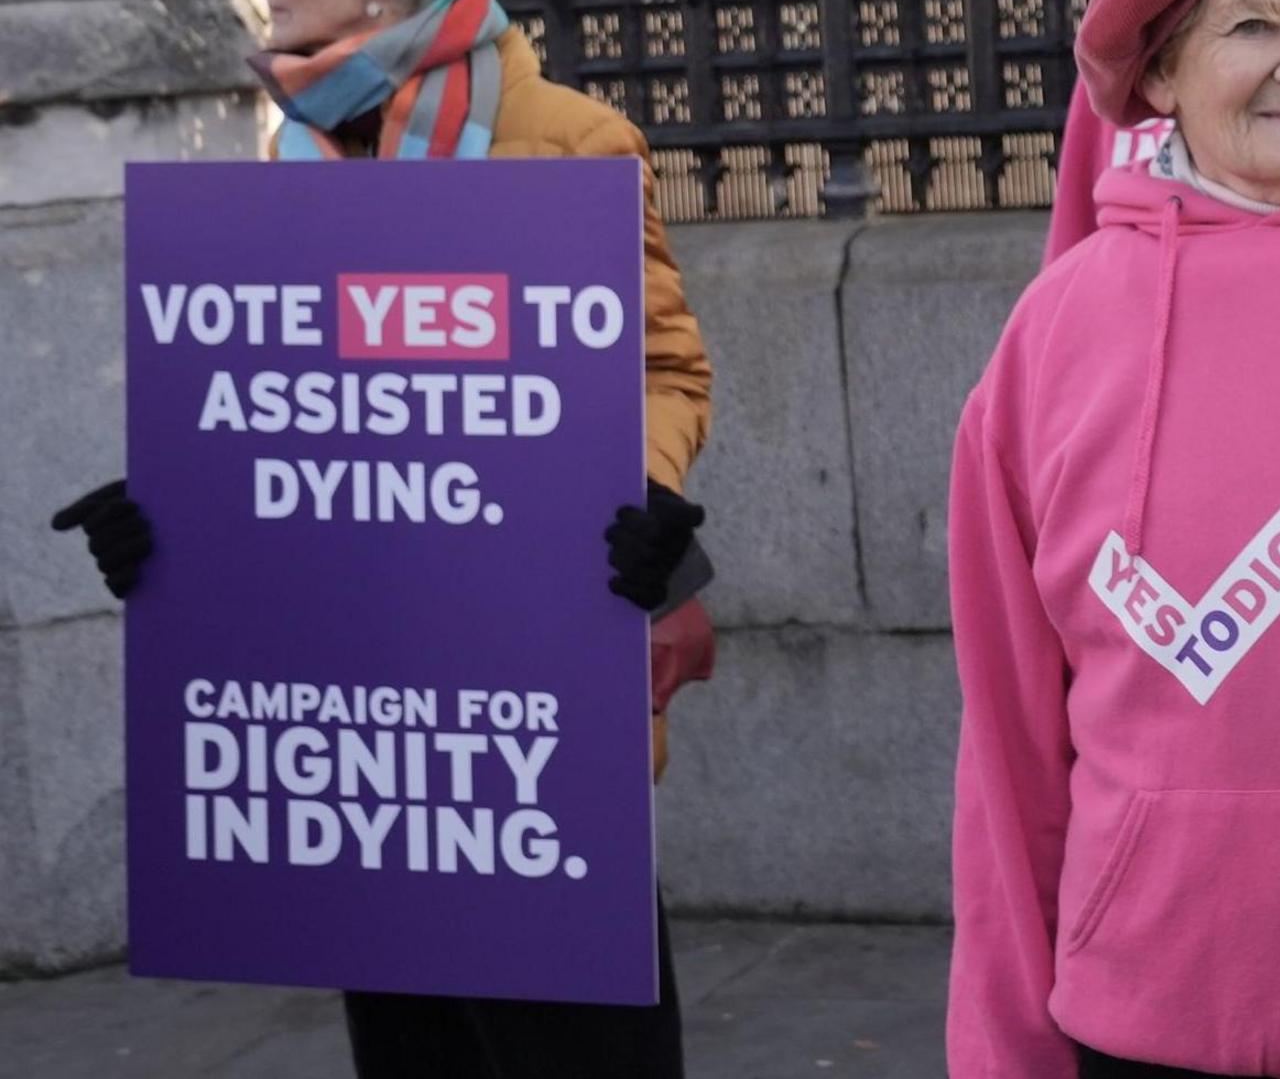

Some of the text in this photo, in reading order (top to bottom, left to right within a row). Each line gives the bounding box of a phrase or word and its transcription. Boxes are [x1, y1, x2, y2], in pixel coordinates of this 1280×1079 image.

[141, 284, 625, 349] VOTE YES TO
[198, 371, 562, 437] ASSISTED
[255, 458, 504, 525] DYING.
[1105, 548, 1187, 647] YES
[185, 679, 559, 731] CAMPAIGN FOR
[185, 722, 558, 805] DIGNITY
[187, 795, 588, 879] IN DYING.
